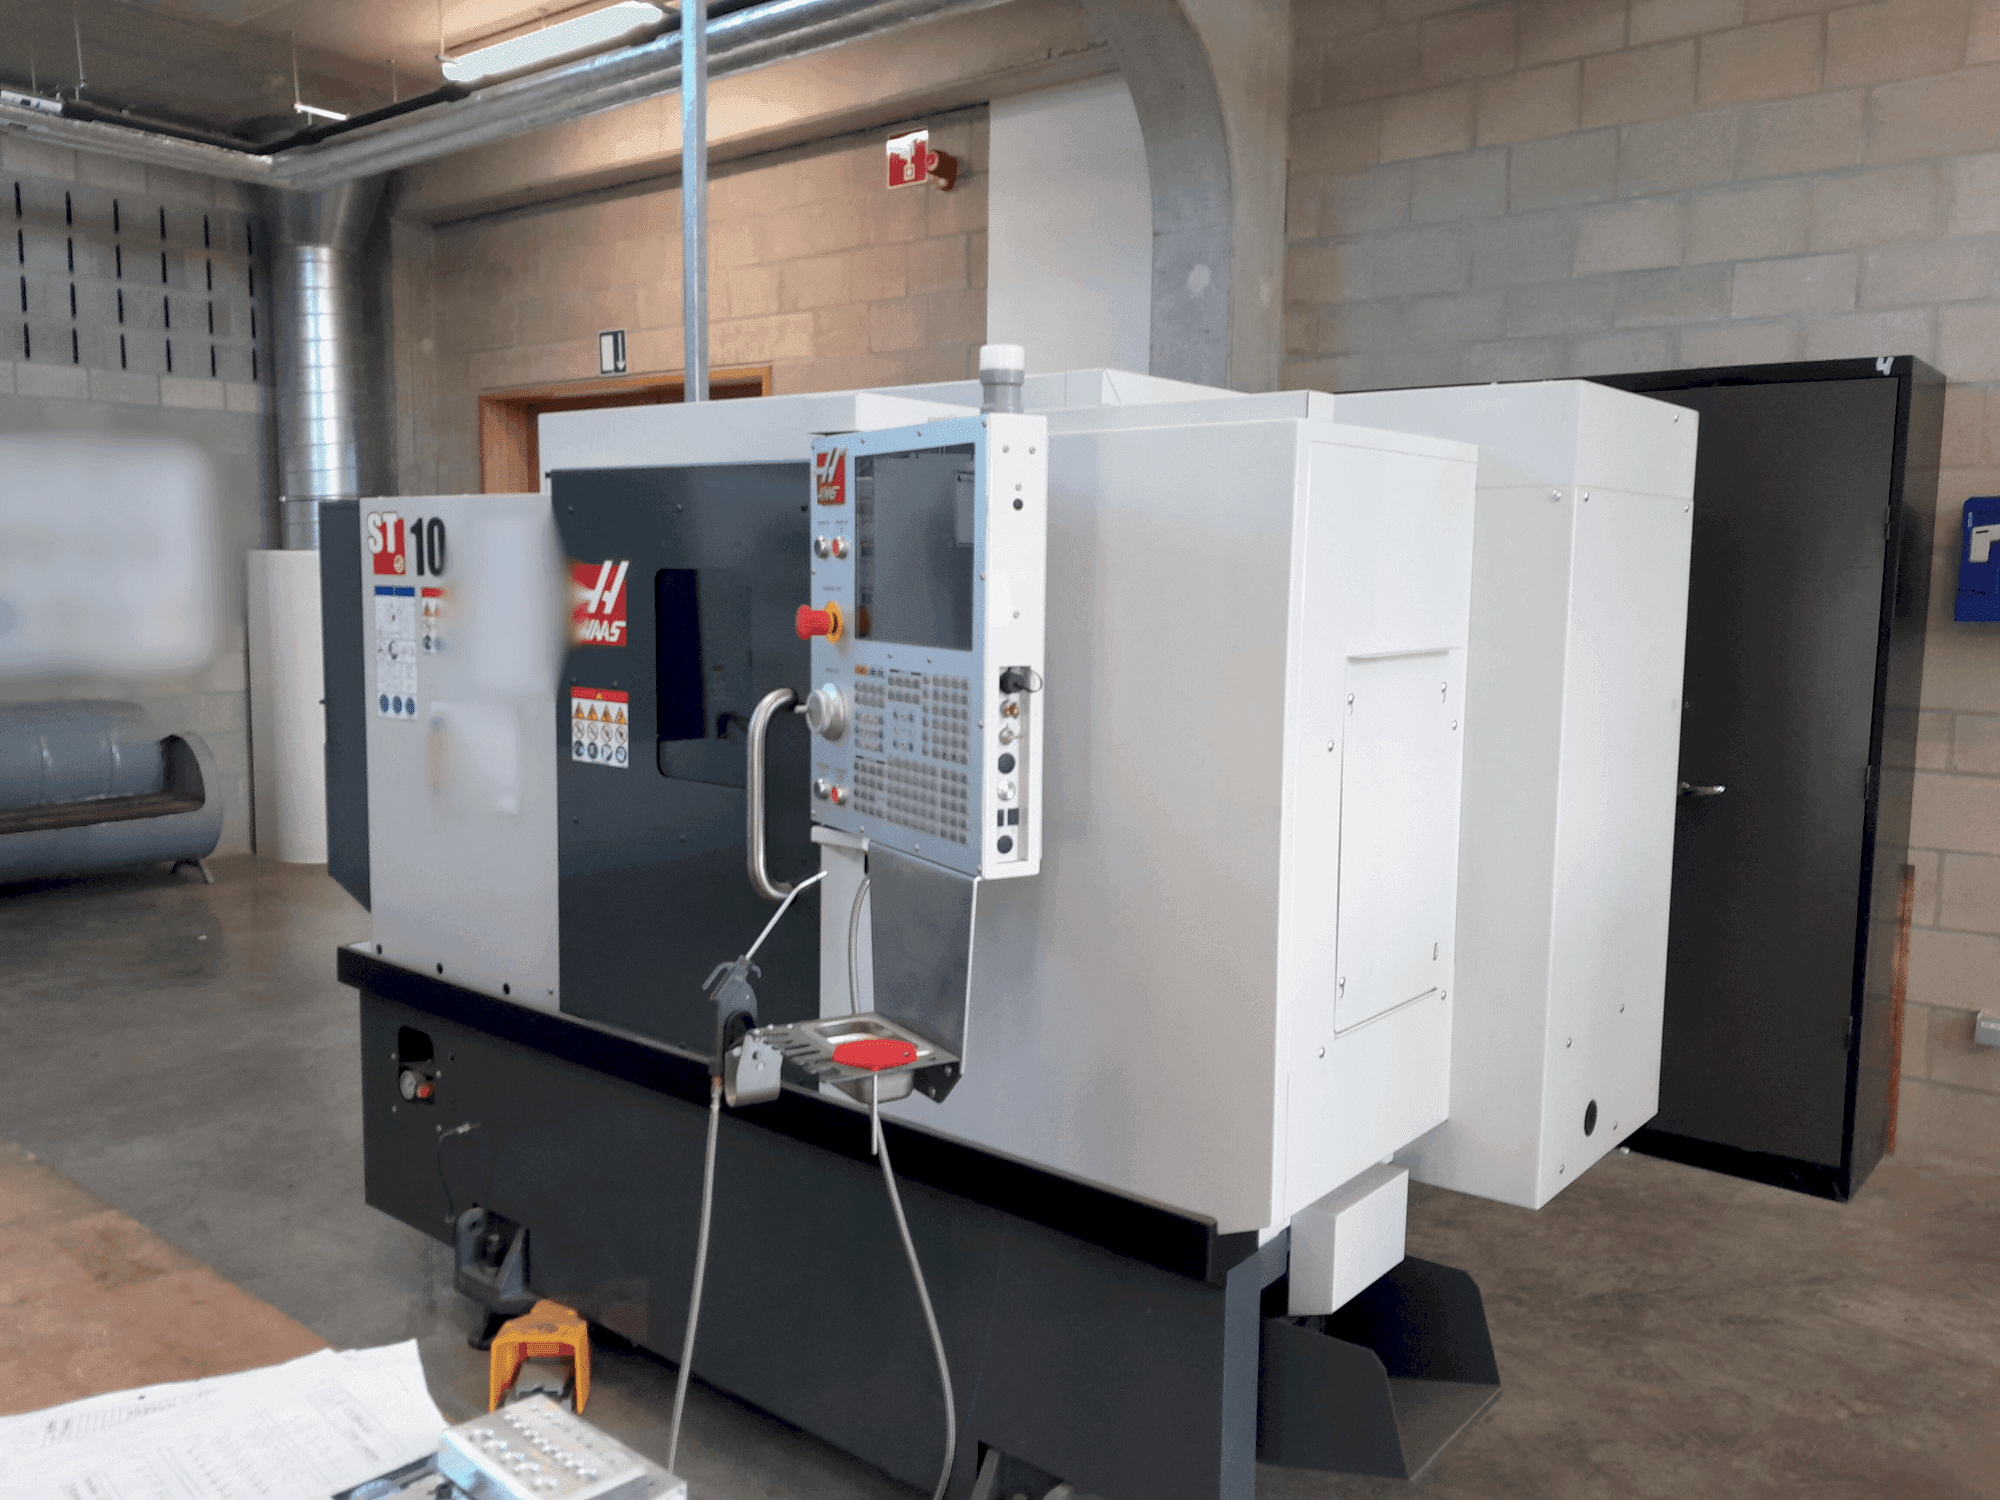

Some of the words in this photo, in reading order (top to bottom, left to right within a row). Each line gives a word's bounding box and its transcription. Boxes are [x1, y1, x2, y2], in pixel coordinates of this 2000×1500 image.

[1875, 356, 1895, 376] 4
[366, 511, 398, 554] ST
[410, 516, 446, 577] 10
